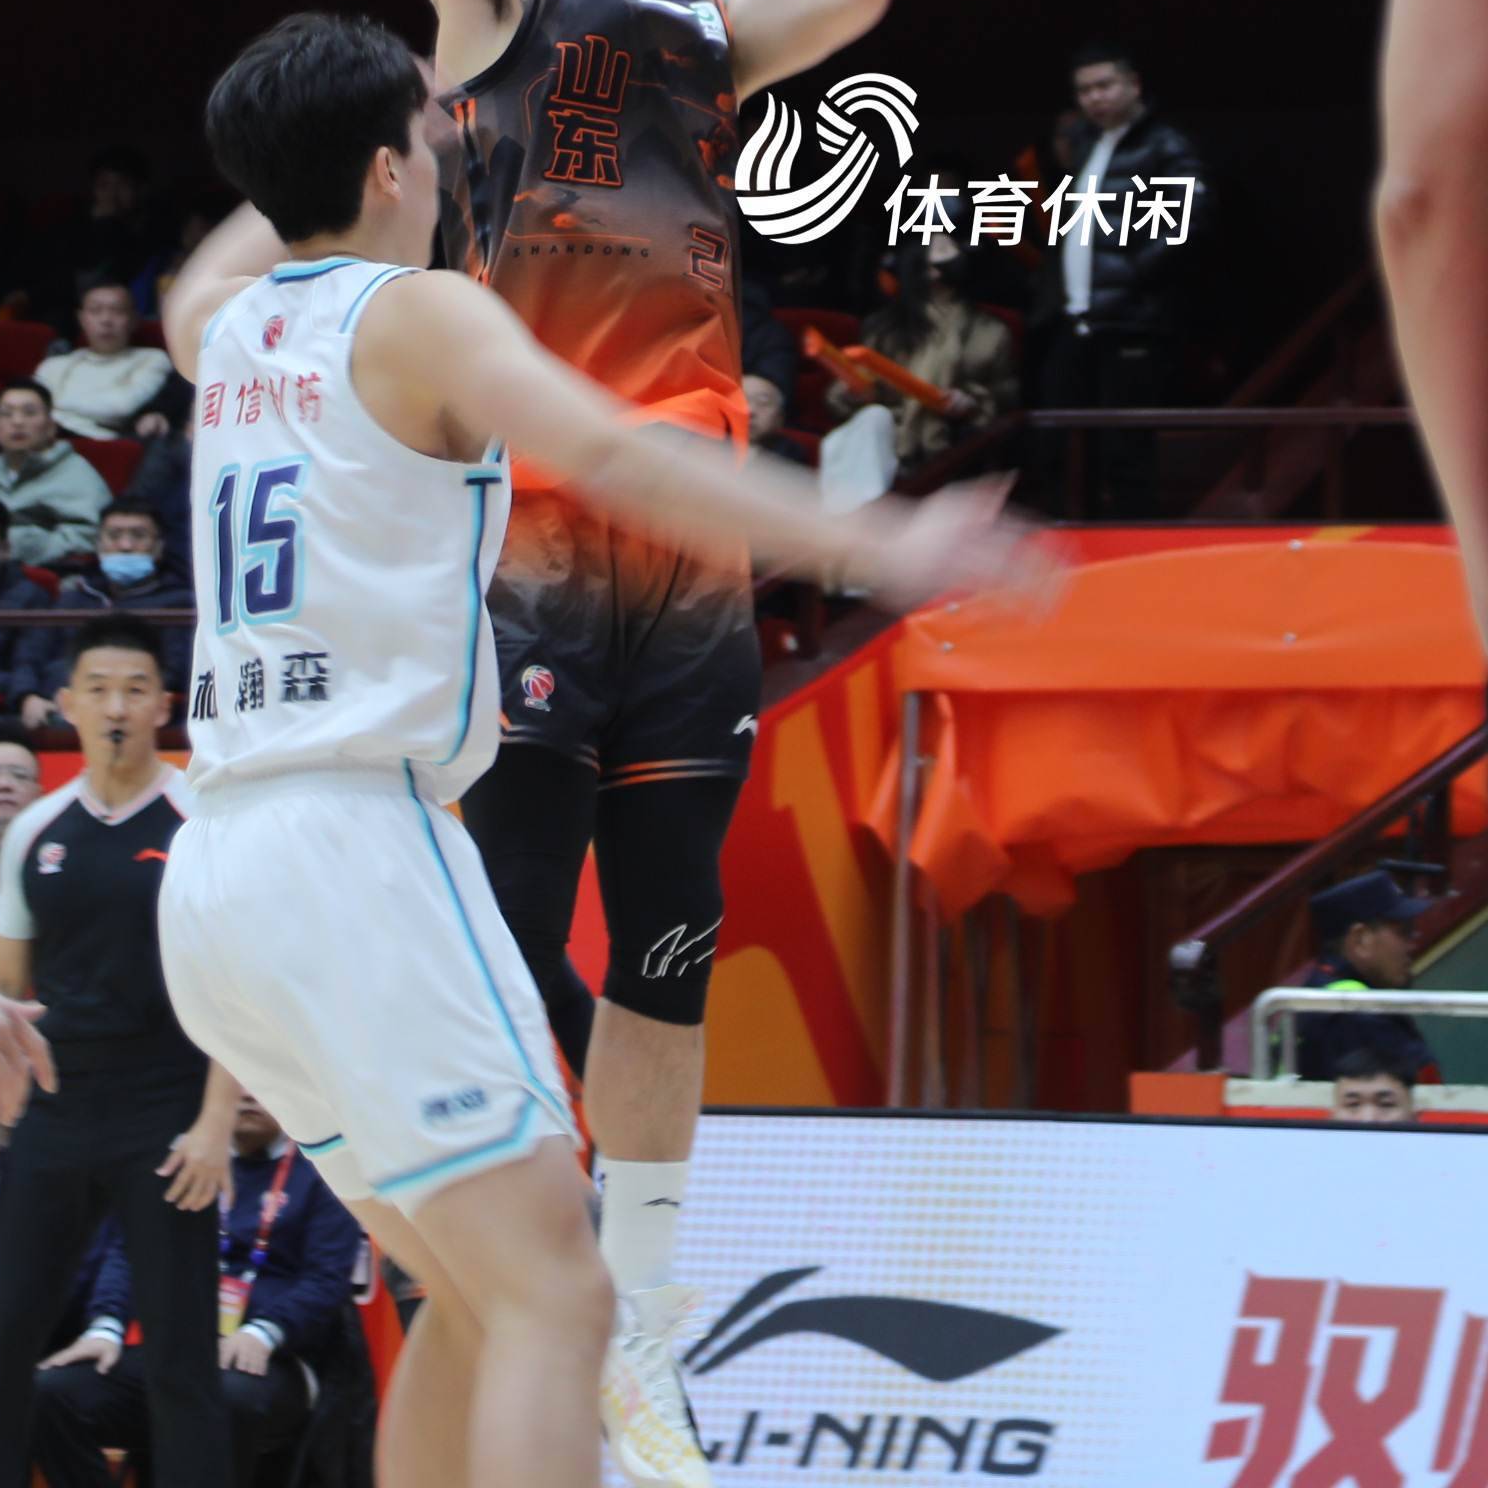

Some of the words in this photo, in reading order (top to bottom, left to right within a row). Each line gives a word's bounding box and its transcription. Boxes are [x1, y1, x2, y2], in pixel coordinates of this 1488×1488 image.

[545, 34, 633, 187] 山东
[512, 244, 650, 259] SHANDONG
[210, 457, 309, 634] 15
